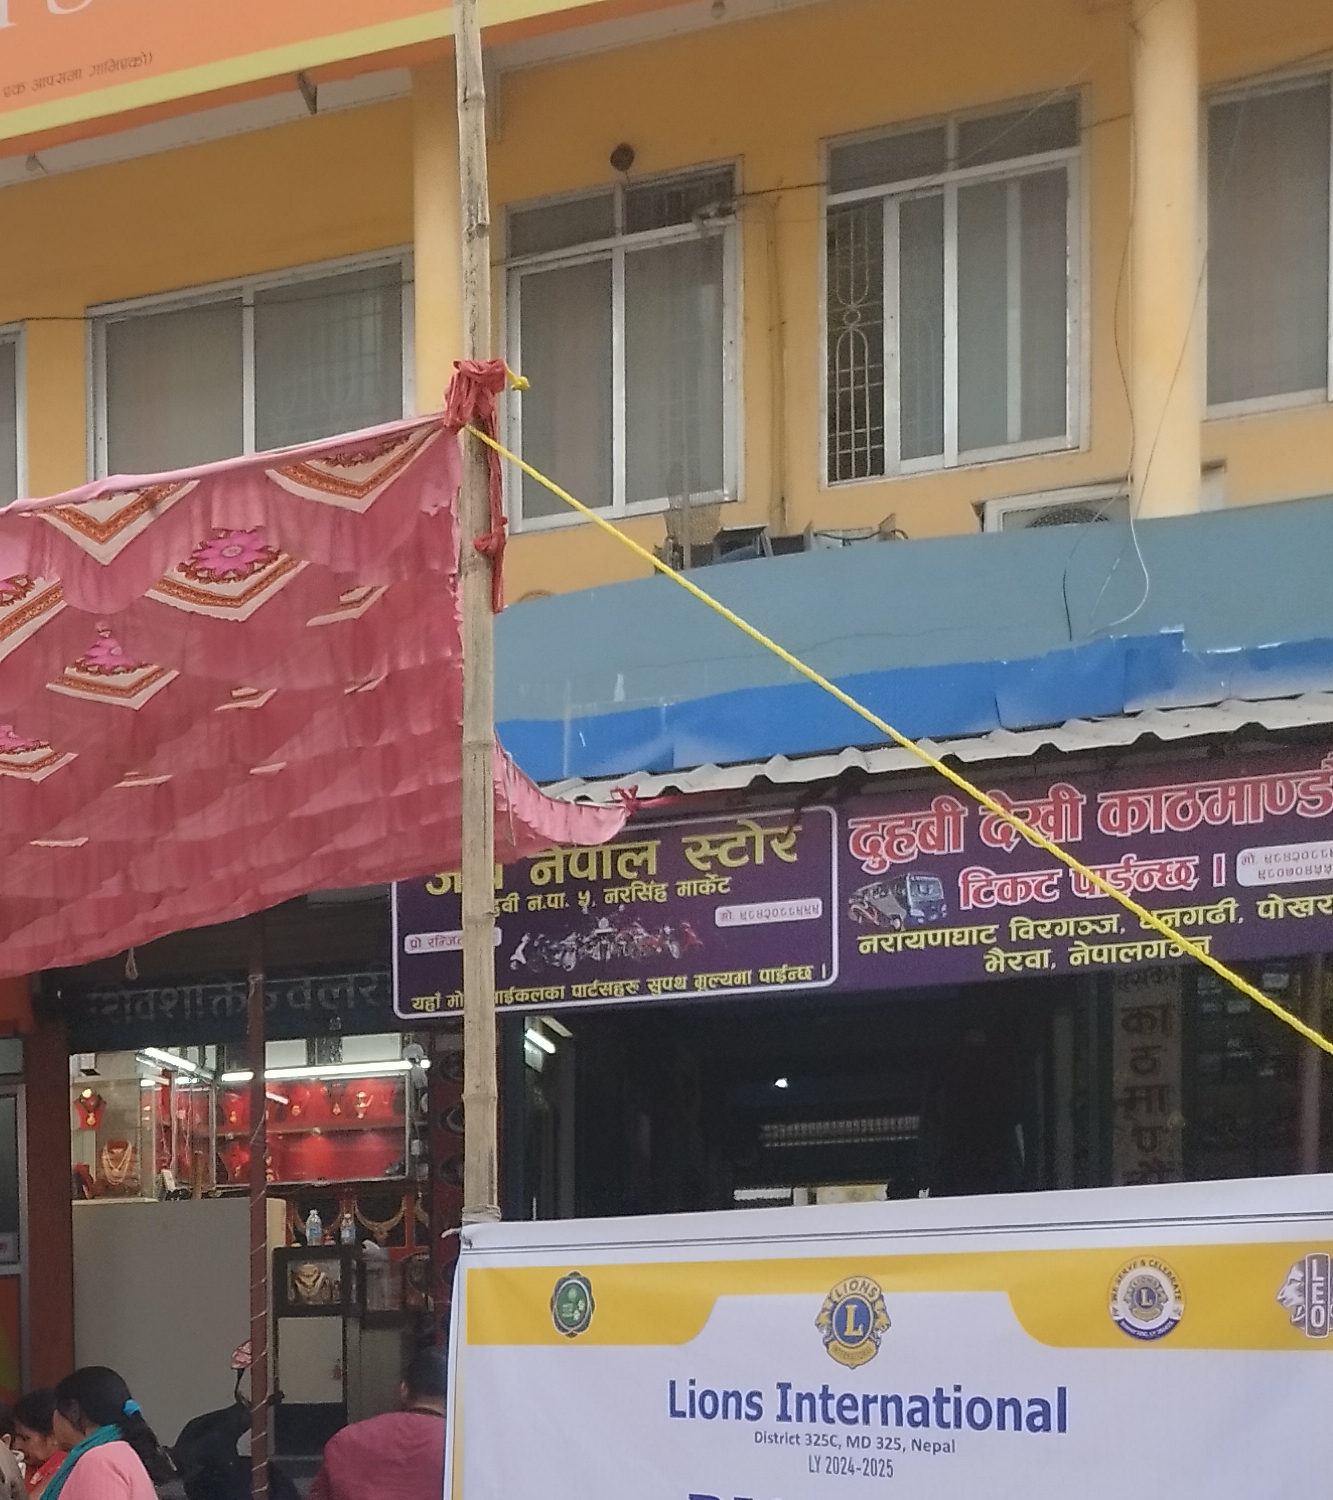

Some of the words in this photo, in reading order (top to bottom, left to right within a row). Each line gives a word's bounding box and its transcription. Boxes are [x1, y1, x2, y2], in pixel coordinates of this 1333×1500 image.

[683, 819, 803, 872] स्टोर
[848, 795, 968, 876] दुहबी
[960, 867, 1062, 911] टिकट
[834, 1276, 879, 1300] LIONS
[1311, 1258, 1325, 1328] LEO
[844, 1304, 863, 1337] L
[668, 1378, 764, 1422] Lions
[775, 1381, 1068, 1434] International
[754, 1431, 801, 1447] District
[804, 1433, 842, 1450] 325C,
[846, 1435, 872, 1450] MD
[875, 1437, 906, 1454] 325,
[911, 1438, 957, 1457] Nepal
[808, 1454, 822, 1474] LY
[825, 1455, 895, 1479] 2024-2025
